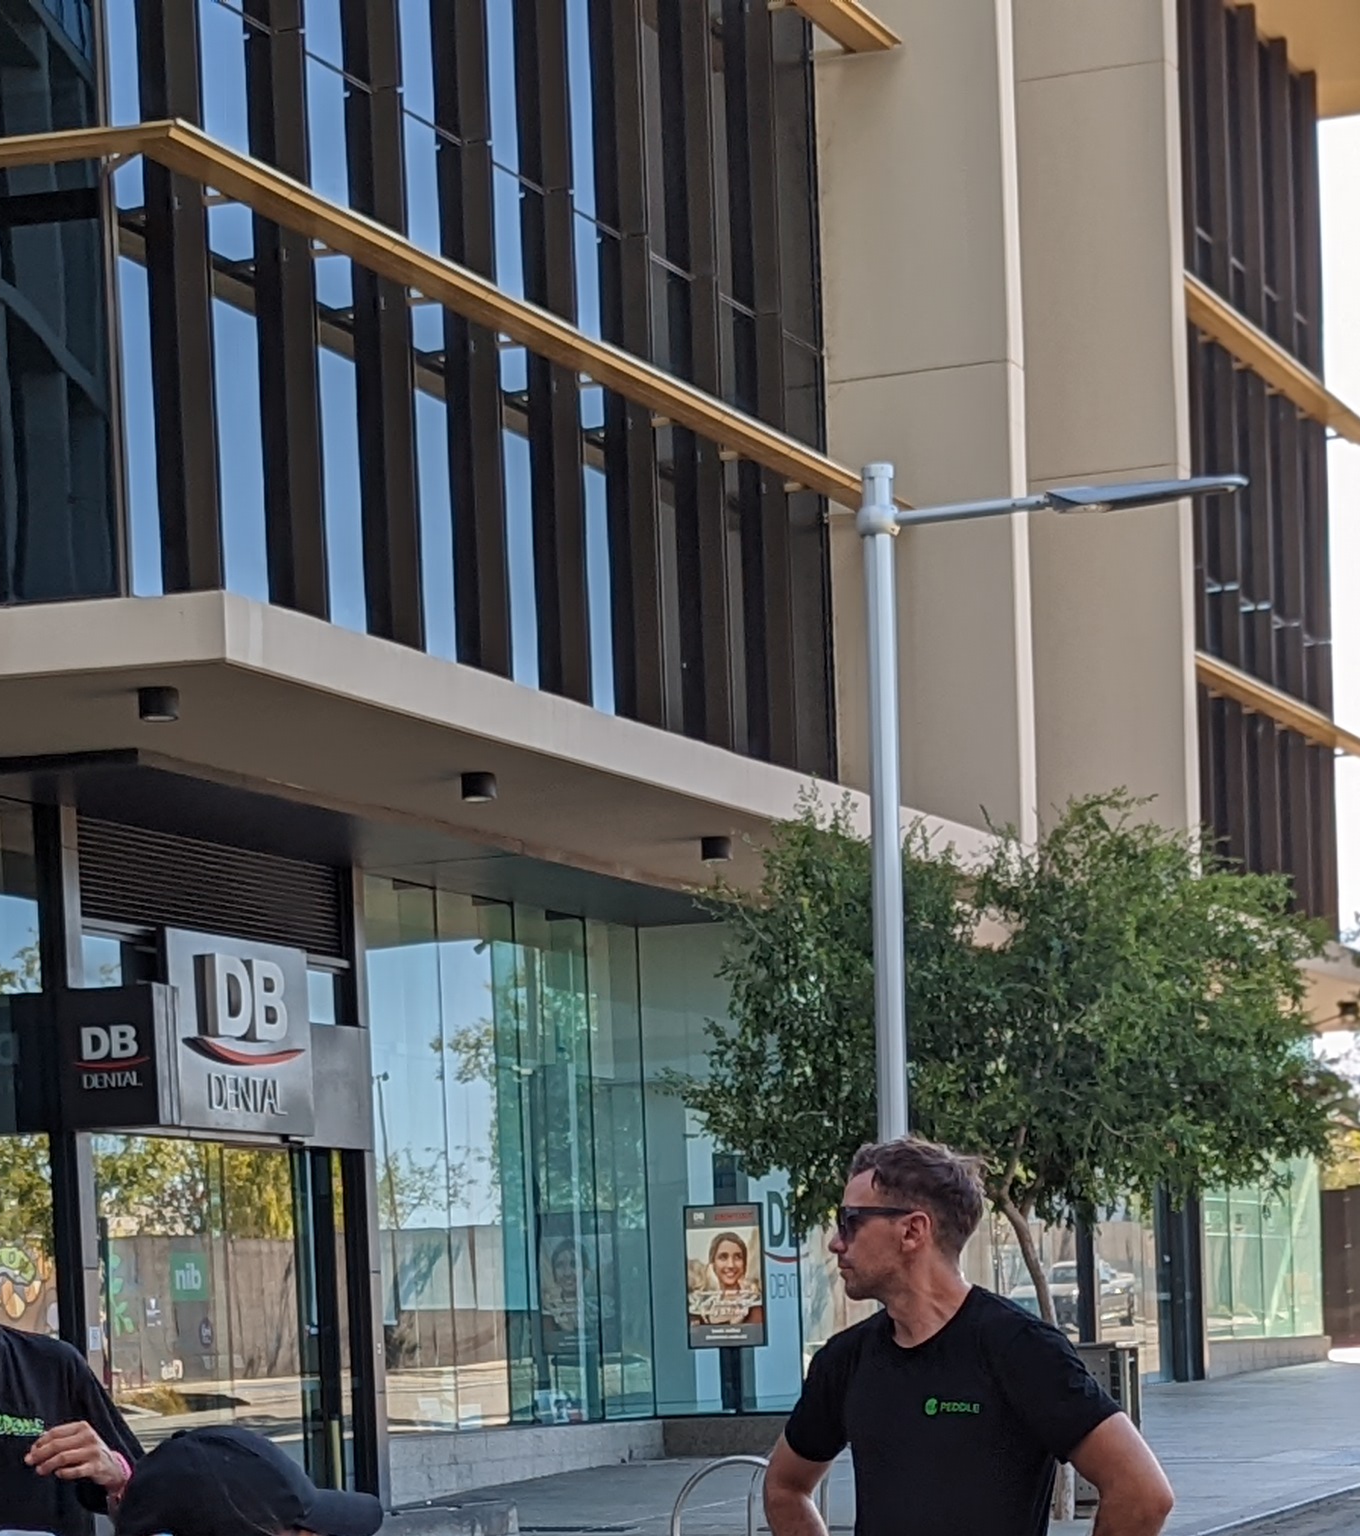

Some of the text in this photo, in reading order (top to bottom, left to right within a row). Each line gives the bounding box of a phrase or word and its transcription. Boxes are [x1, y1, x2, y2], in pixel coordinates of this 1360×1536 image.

[215, 953, 288, 1041] DB
[80, 1024, 139, 1061] DB
[82, 1071, 143, 1090] DENTAL
[209, 1073, 288, 1116] DENTAL
